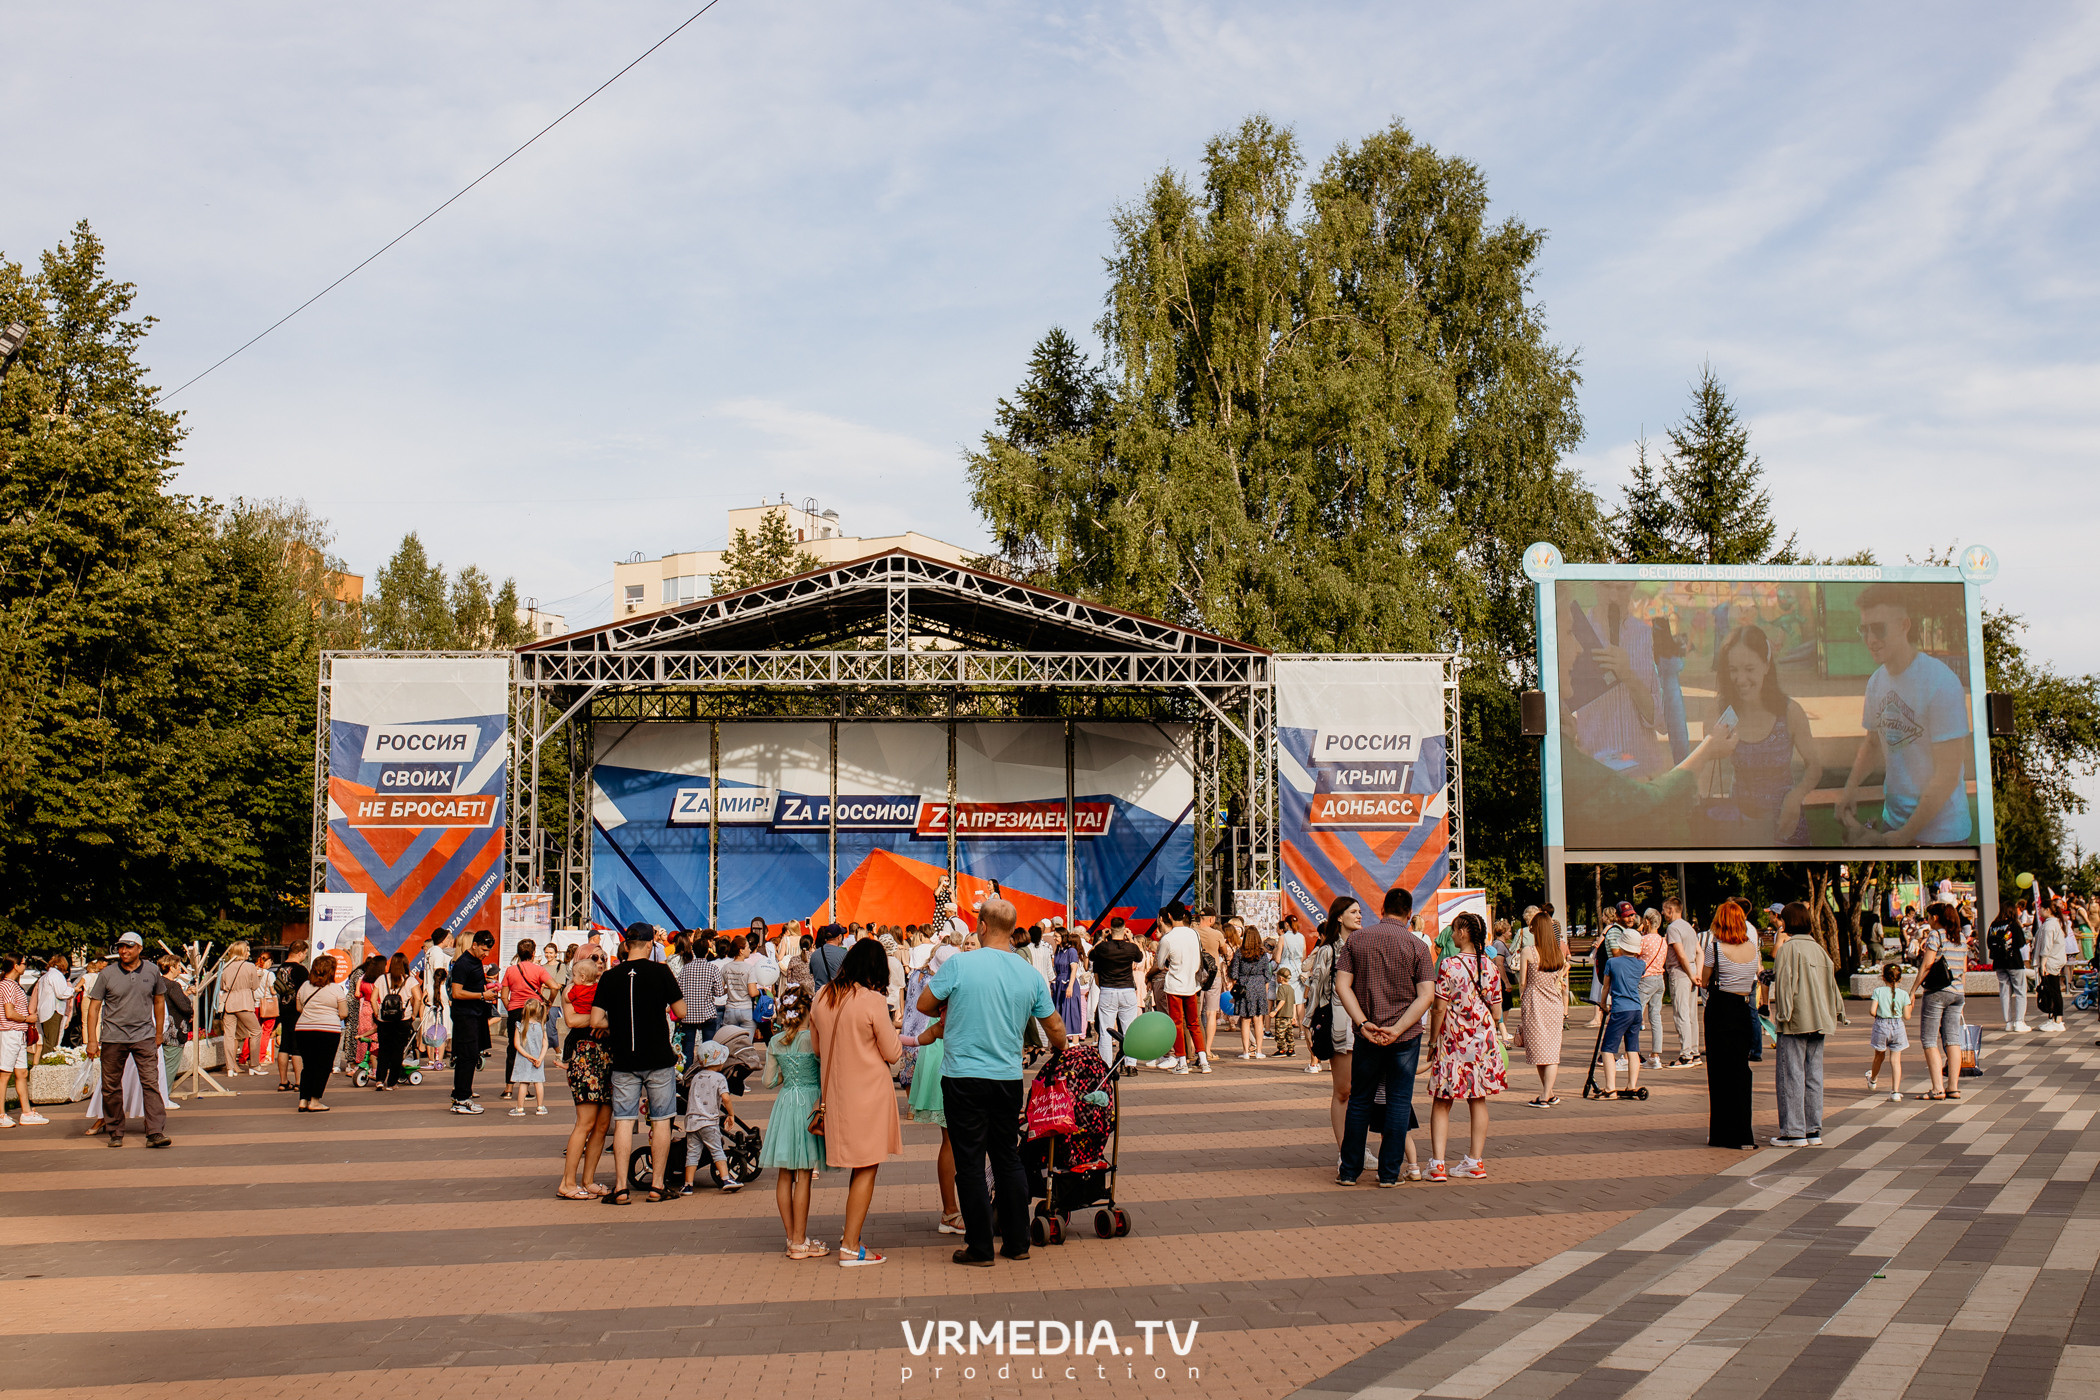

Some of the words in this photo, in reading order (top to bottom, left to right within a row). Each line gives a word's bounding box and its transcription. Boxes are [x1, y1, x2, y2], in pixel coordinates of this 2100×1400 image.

[1638, 566, 1713, 579] ФЕСТИВАЛЬ
[1717, 566, 1811, 580] БОЛЕЛЬЩИКОВ
[1816, 566, 1882, 580] КЕМЕРОВО
[376, 734, 467, 751] РОССИЯ
[1325, 734, 1411, 751] РОССИЯ
[382, 770, 452, 787] СВОИХ
[1335, 769, 1397, 786] КРЫМ
[358, 801, 385, 818] НЕ
[389, 800, 487, 818] БРОСАЕТ!
[719, 797, 770, 813] МИР!
[817, 802, 915, 821] РОССИЮ!
[1320, 799, 1413, 818] ДОНБАСС
[971, 811, 1102, 830] ПРЕЗИДЕНТА!
[460, 872, 498, 918] ПРЕЗИДЕНТА!
[1287, 880, 1319, 914] РОССИЯ
